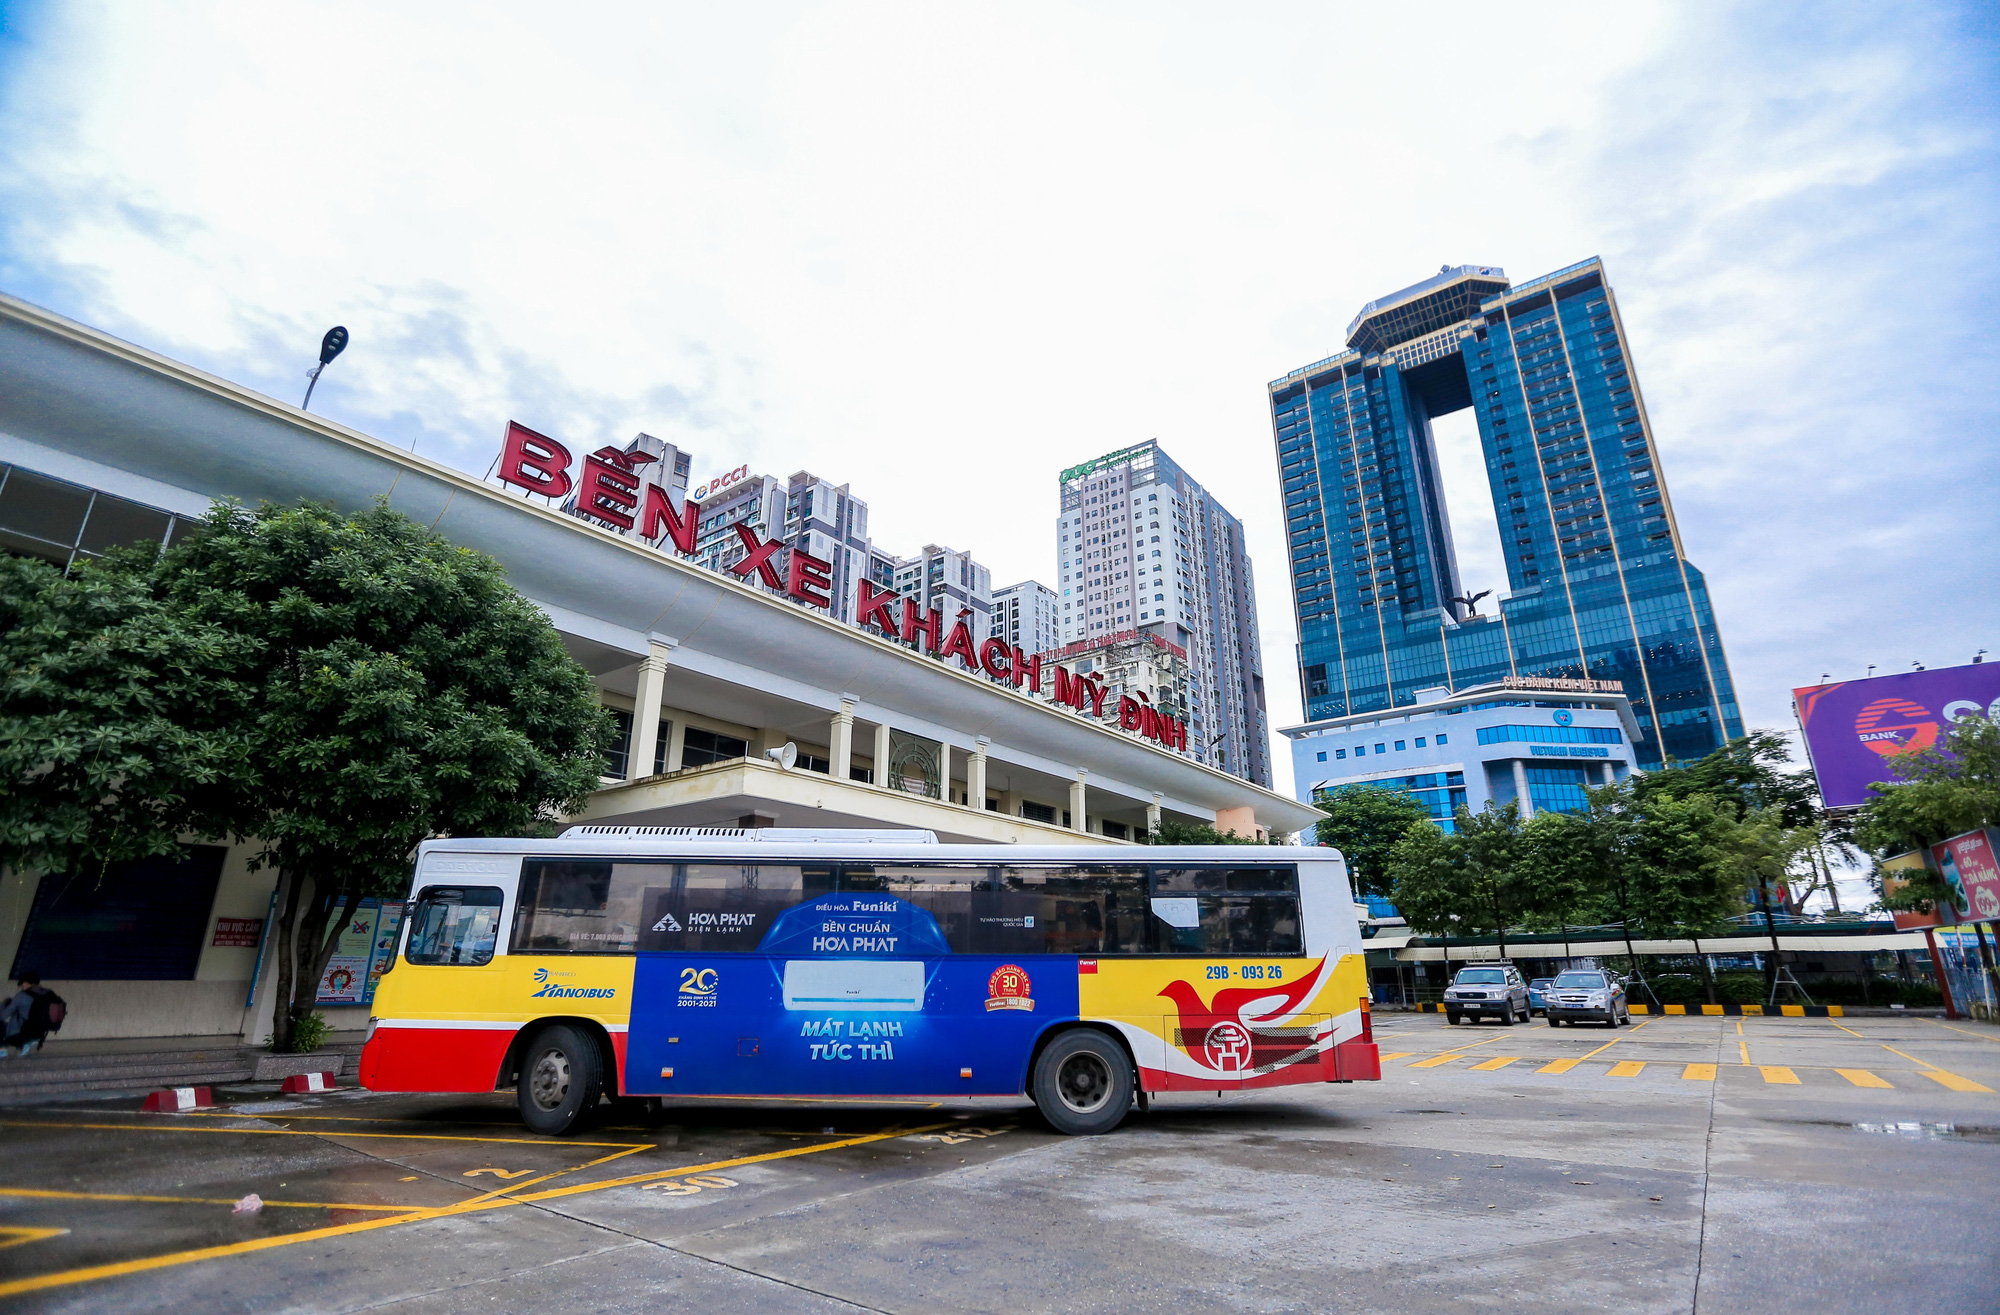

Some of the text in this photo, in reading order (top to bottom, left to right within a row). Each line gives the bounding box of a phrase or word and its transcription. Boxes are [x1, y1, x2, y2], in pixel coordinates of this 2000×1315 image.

[710, 464, 747, 493] PCC1
[496, 420, 1186, 752] BẾN XE KHÁCH MỸ ĐÌNH
[1600, 680, 1624, 691] NAM
[1859, 730, 1899, 742] BANK
[1529, 745, 1609, 757] VIETNAM REGISTER
[852, 901, 897, 912] Funiki
[720, 913, 756, 925] PHÁT
[822, 919, 845, 932] BỀN
[217, 922, 231, 931] KHU
[231, 922, 245, 934] VỰC
[716, 926, 741, 934] LẠNH
[853, 937, 898, 952] PHÁT
[1206, 966, 1229, 979] 29B
[1241, 966, 1264, 979] 093
[1267, 966, 1282, 979] 26
[679, 968, 719, 995] 20
[1002, 975, 1018, 988] 30
[531, 984, 616, 998] HANOIBUS
[800, 1017, 904, 1042] MÁT LẠNH
[810, 1040, 894, 1060] TỨC THÌ
[641, 1176, 739, 1196] 30
